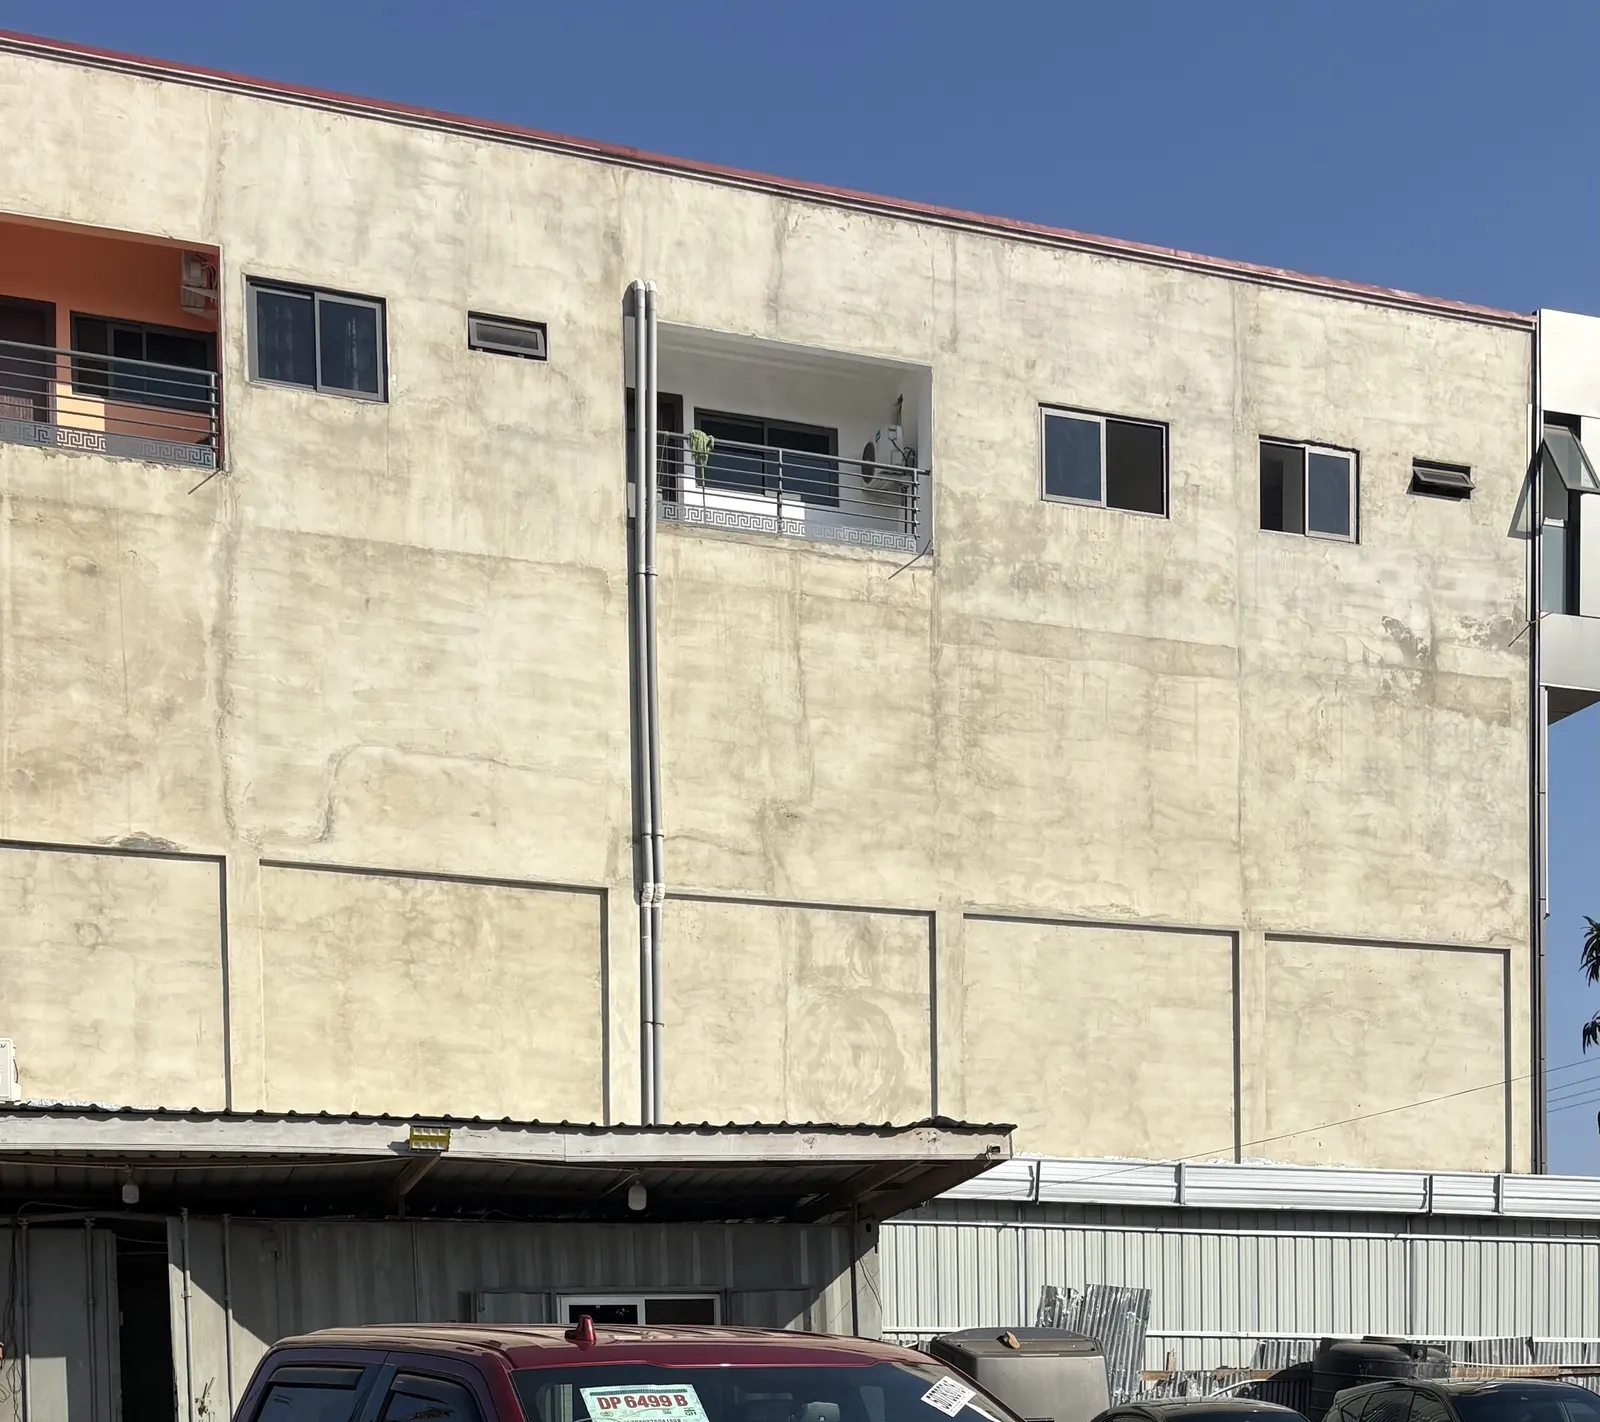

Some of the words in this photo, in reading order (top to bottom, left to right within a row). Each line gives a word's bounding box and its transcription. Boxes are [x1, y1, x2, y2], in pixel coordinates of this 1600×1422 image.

[597, 1396, 621, 1410] DP
[624, 1395, 672, 1409] 6499
[674, 1394, 689, 1407] B
